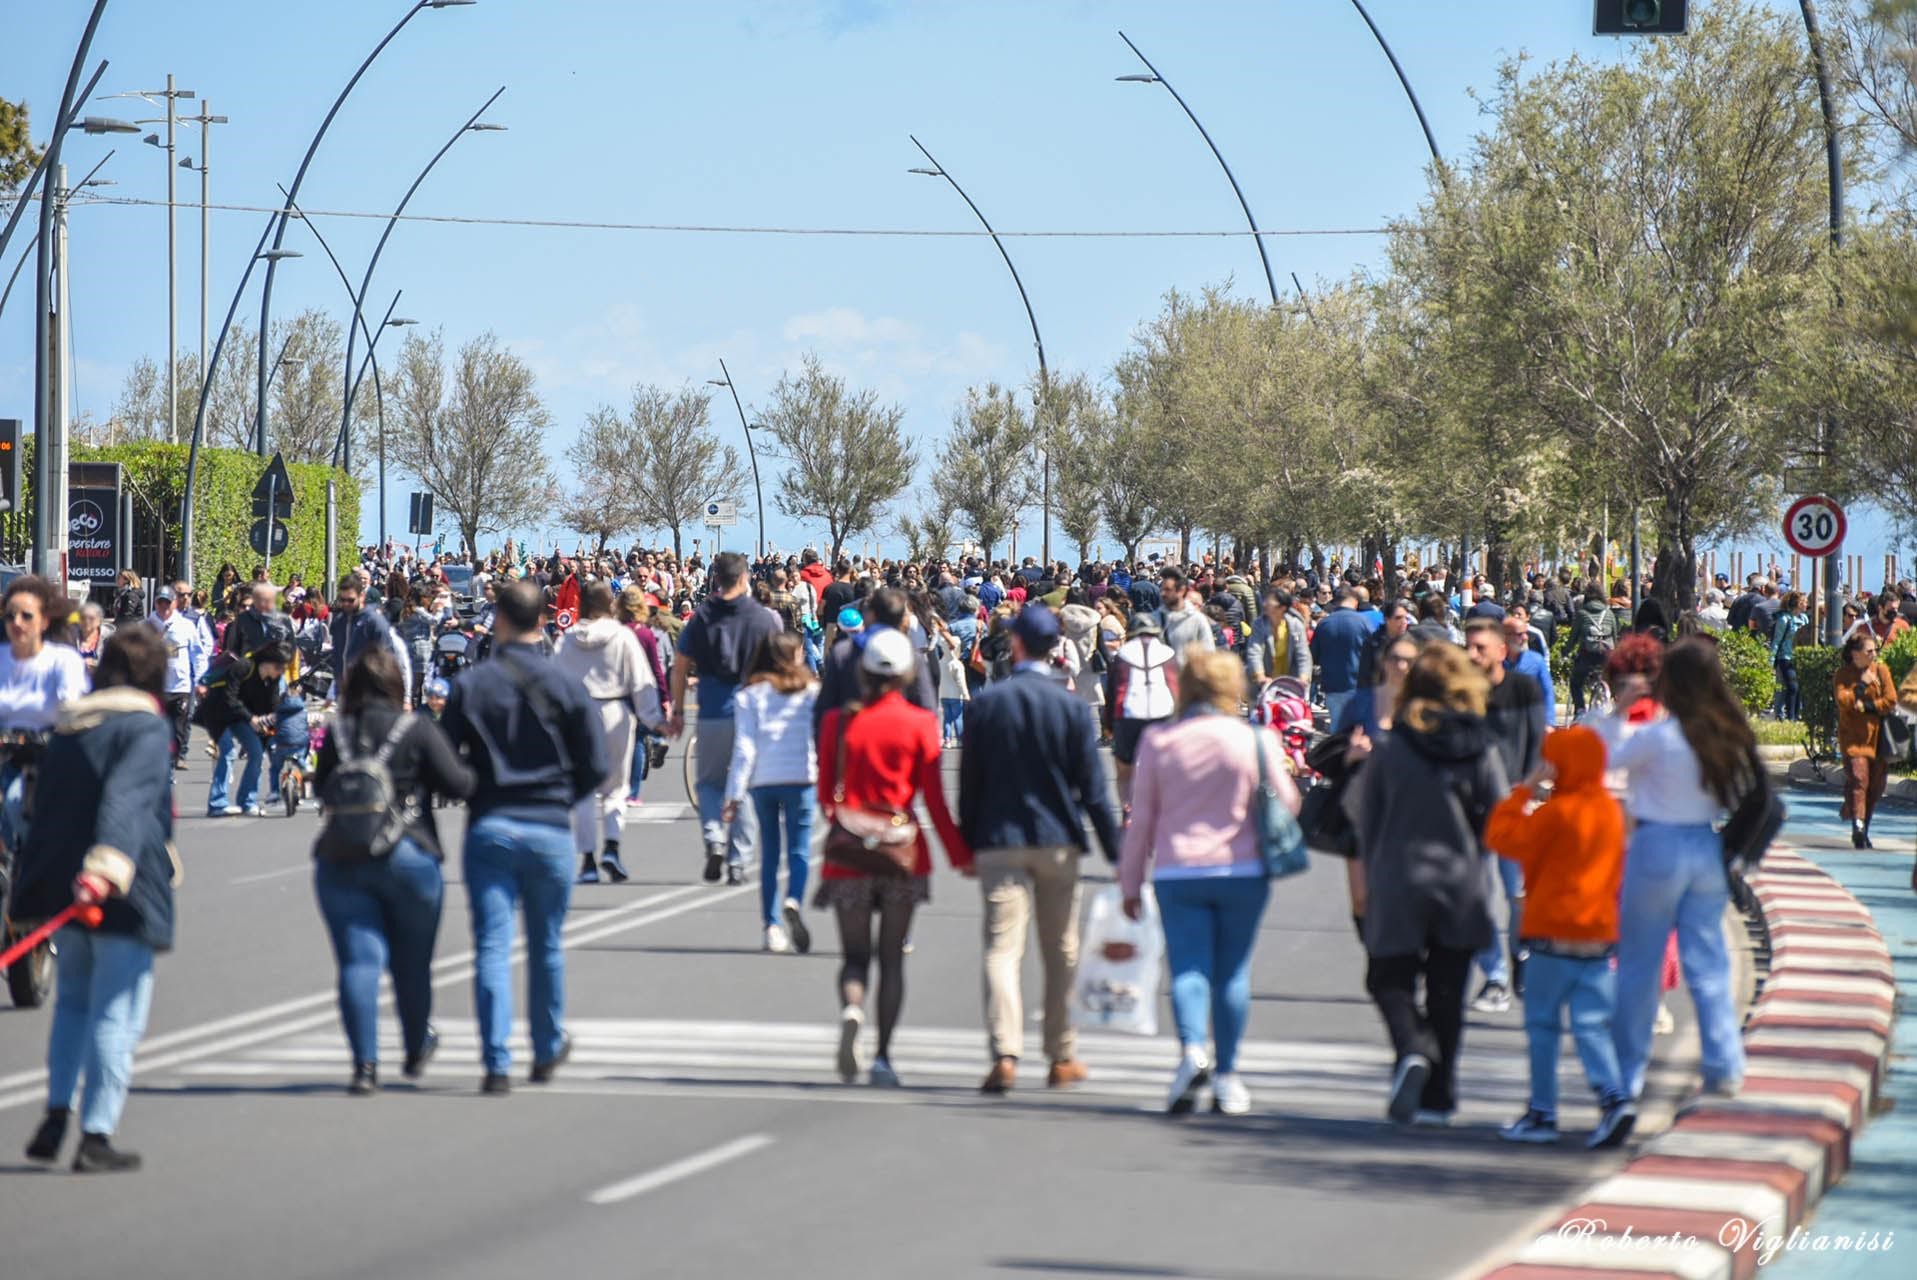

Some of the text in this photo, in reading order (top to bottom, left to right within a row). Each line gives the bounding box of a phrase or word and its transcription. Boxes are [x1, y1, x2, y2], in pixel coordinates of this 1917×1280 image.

[1798, 513, 1833, 541] 30
[69, 538, 111, 550] perstore
[68, 567, 115, 577] NGRESSO
